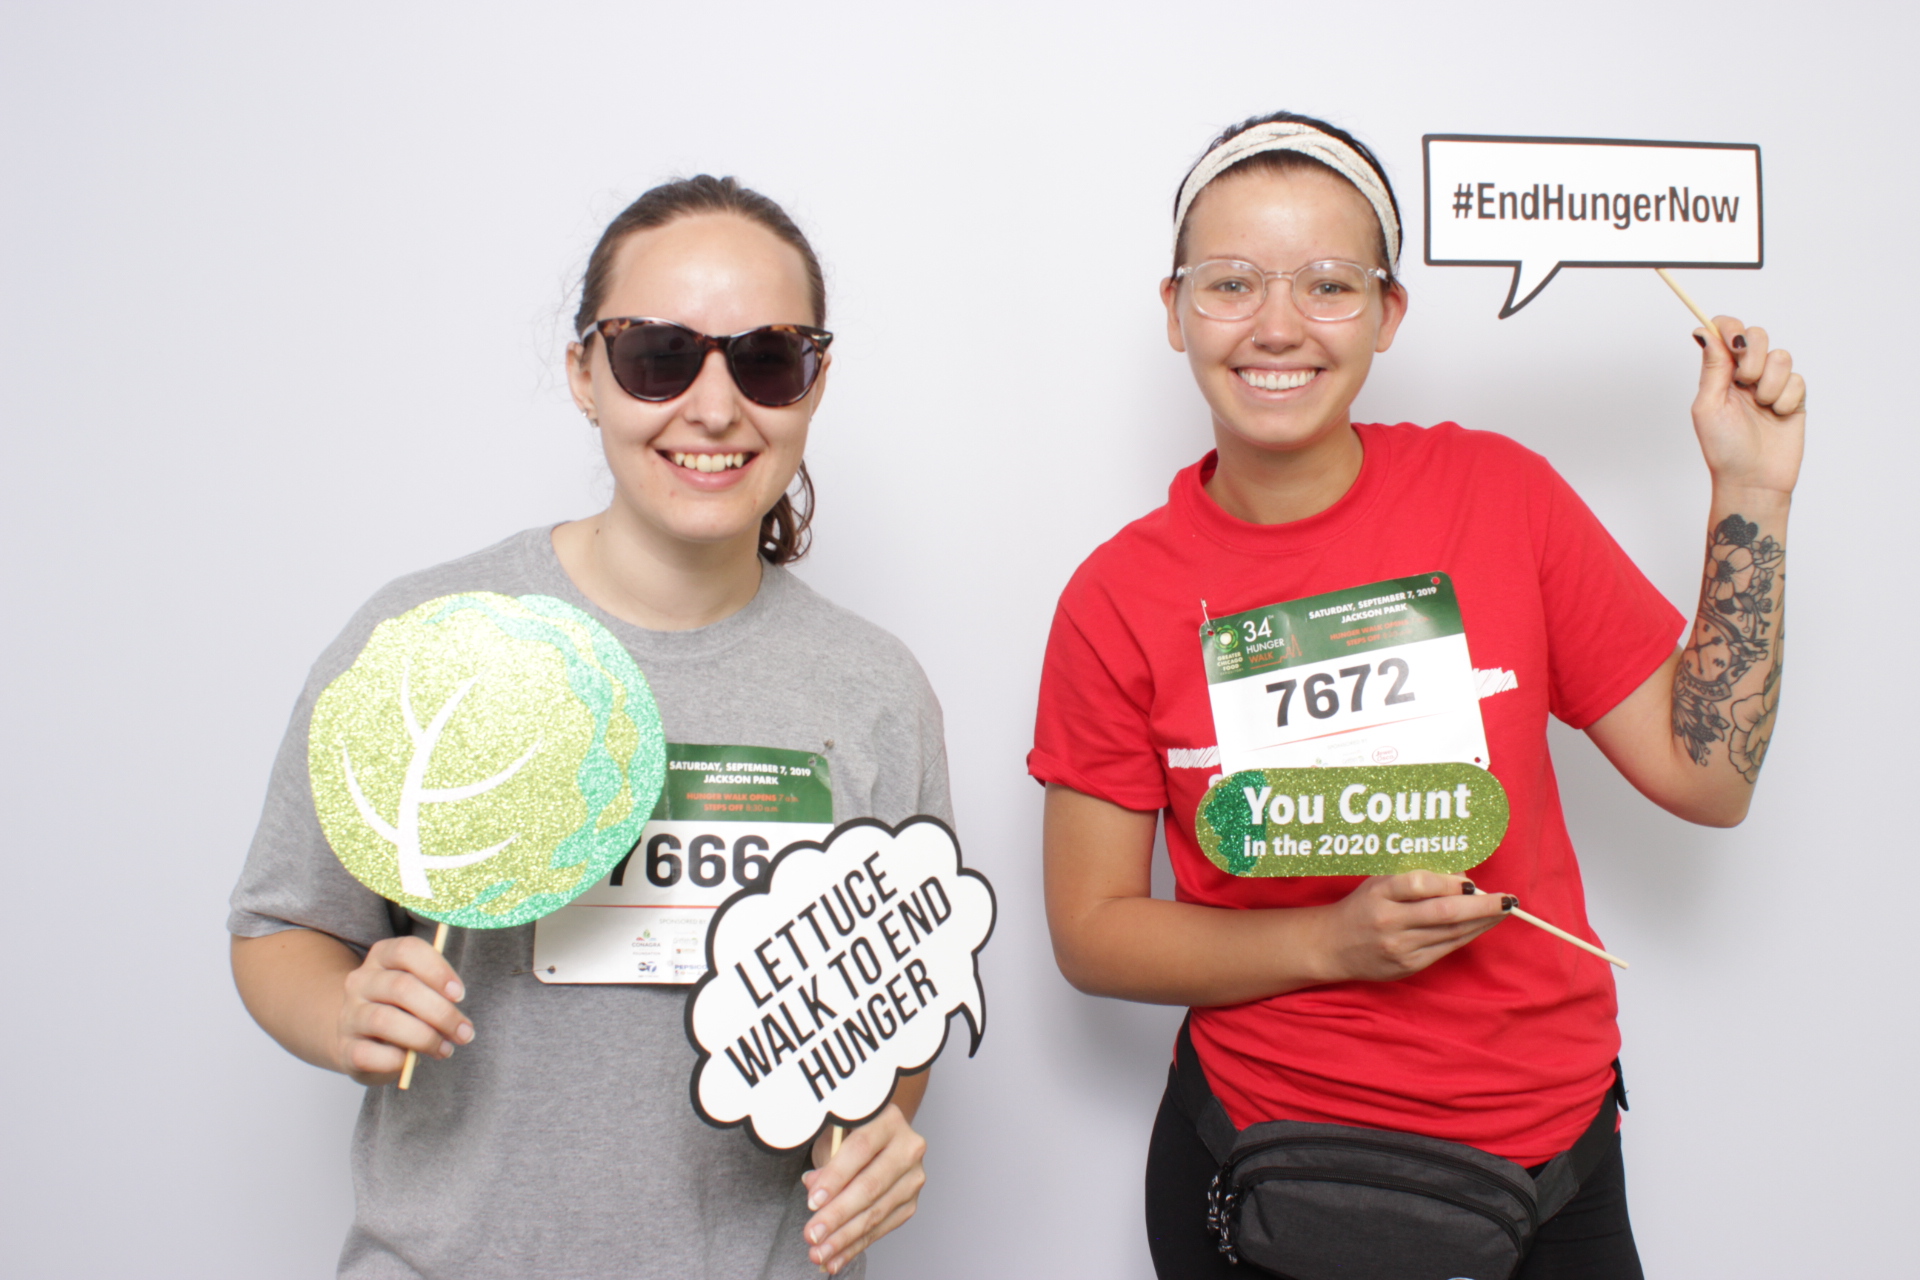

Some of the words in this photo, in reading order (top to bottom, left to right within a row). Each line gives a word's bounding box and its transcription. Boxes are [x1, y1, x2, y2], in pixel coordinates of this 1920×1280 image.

[1452, 181, 1740, 230] #EndHungerNow
[1308, 602, 1356, 620] SATURDAY,
[1357, 592, 1406, 609] SEPTEMBER
[1407, 590, 1415, 600] 7,
[1416, 586, 1438, 597] 2019
[1341, 607, 1382, 624] JACKSON
[1383, 603, 1408, 615] PARK
[1330, 628, 1361, 640] HUNGER
[1361, 624, 1384, 634] WALK
[1246, 638, 1285, 654] HUNGER
[1346, 637, 1367, 647] STEPS
[1217, 651, 1242, 661] GREATER
[1217, 657, 1243, 667] CHICAGO
[1249, 651, 1274, 663] WALK
[1265, 657, 1416, 728] 7672
[669, 761, 723, 772] SATURDAY,
[725, 762, 779, 774] SEPTEMBER
[780, 765, 788, 776] 7,
[790, 767, 812, 777] 2019
[703, 774, 751, 784] JACKSON
[753, 775, 779, 785] PARK
[686, 792, 722, 801] HUNGER
[724, 793, 748, 801] WALK
[749, 794, 777, 802] OPENS
[1243, 786, 1325, 825] You
[1339, 783, 1472, 824] Count
[703, 803, 727, 812] STEPS
[728, 804, 744, 812] OFF
[1243, 835, 1267, 858] in
[1273, 834, 1312, 856] the
[1318, 833, 1380, 856] 2020
[1386, 831, 1469, 855] Census
[734, 851, 898, 1009] LETTUCE
[724, 974, 838, 1089] WALK
[827, 936, 882, 1000] TO
[877, 876, 952, 963] END
[797, 958, 939, 1103] HUNGER
